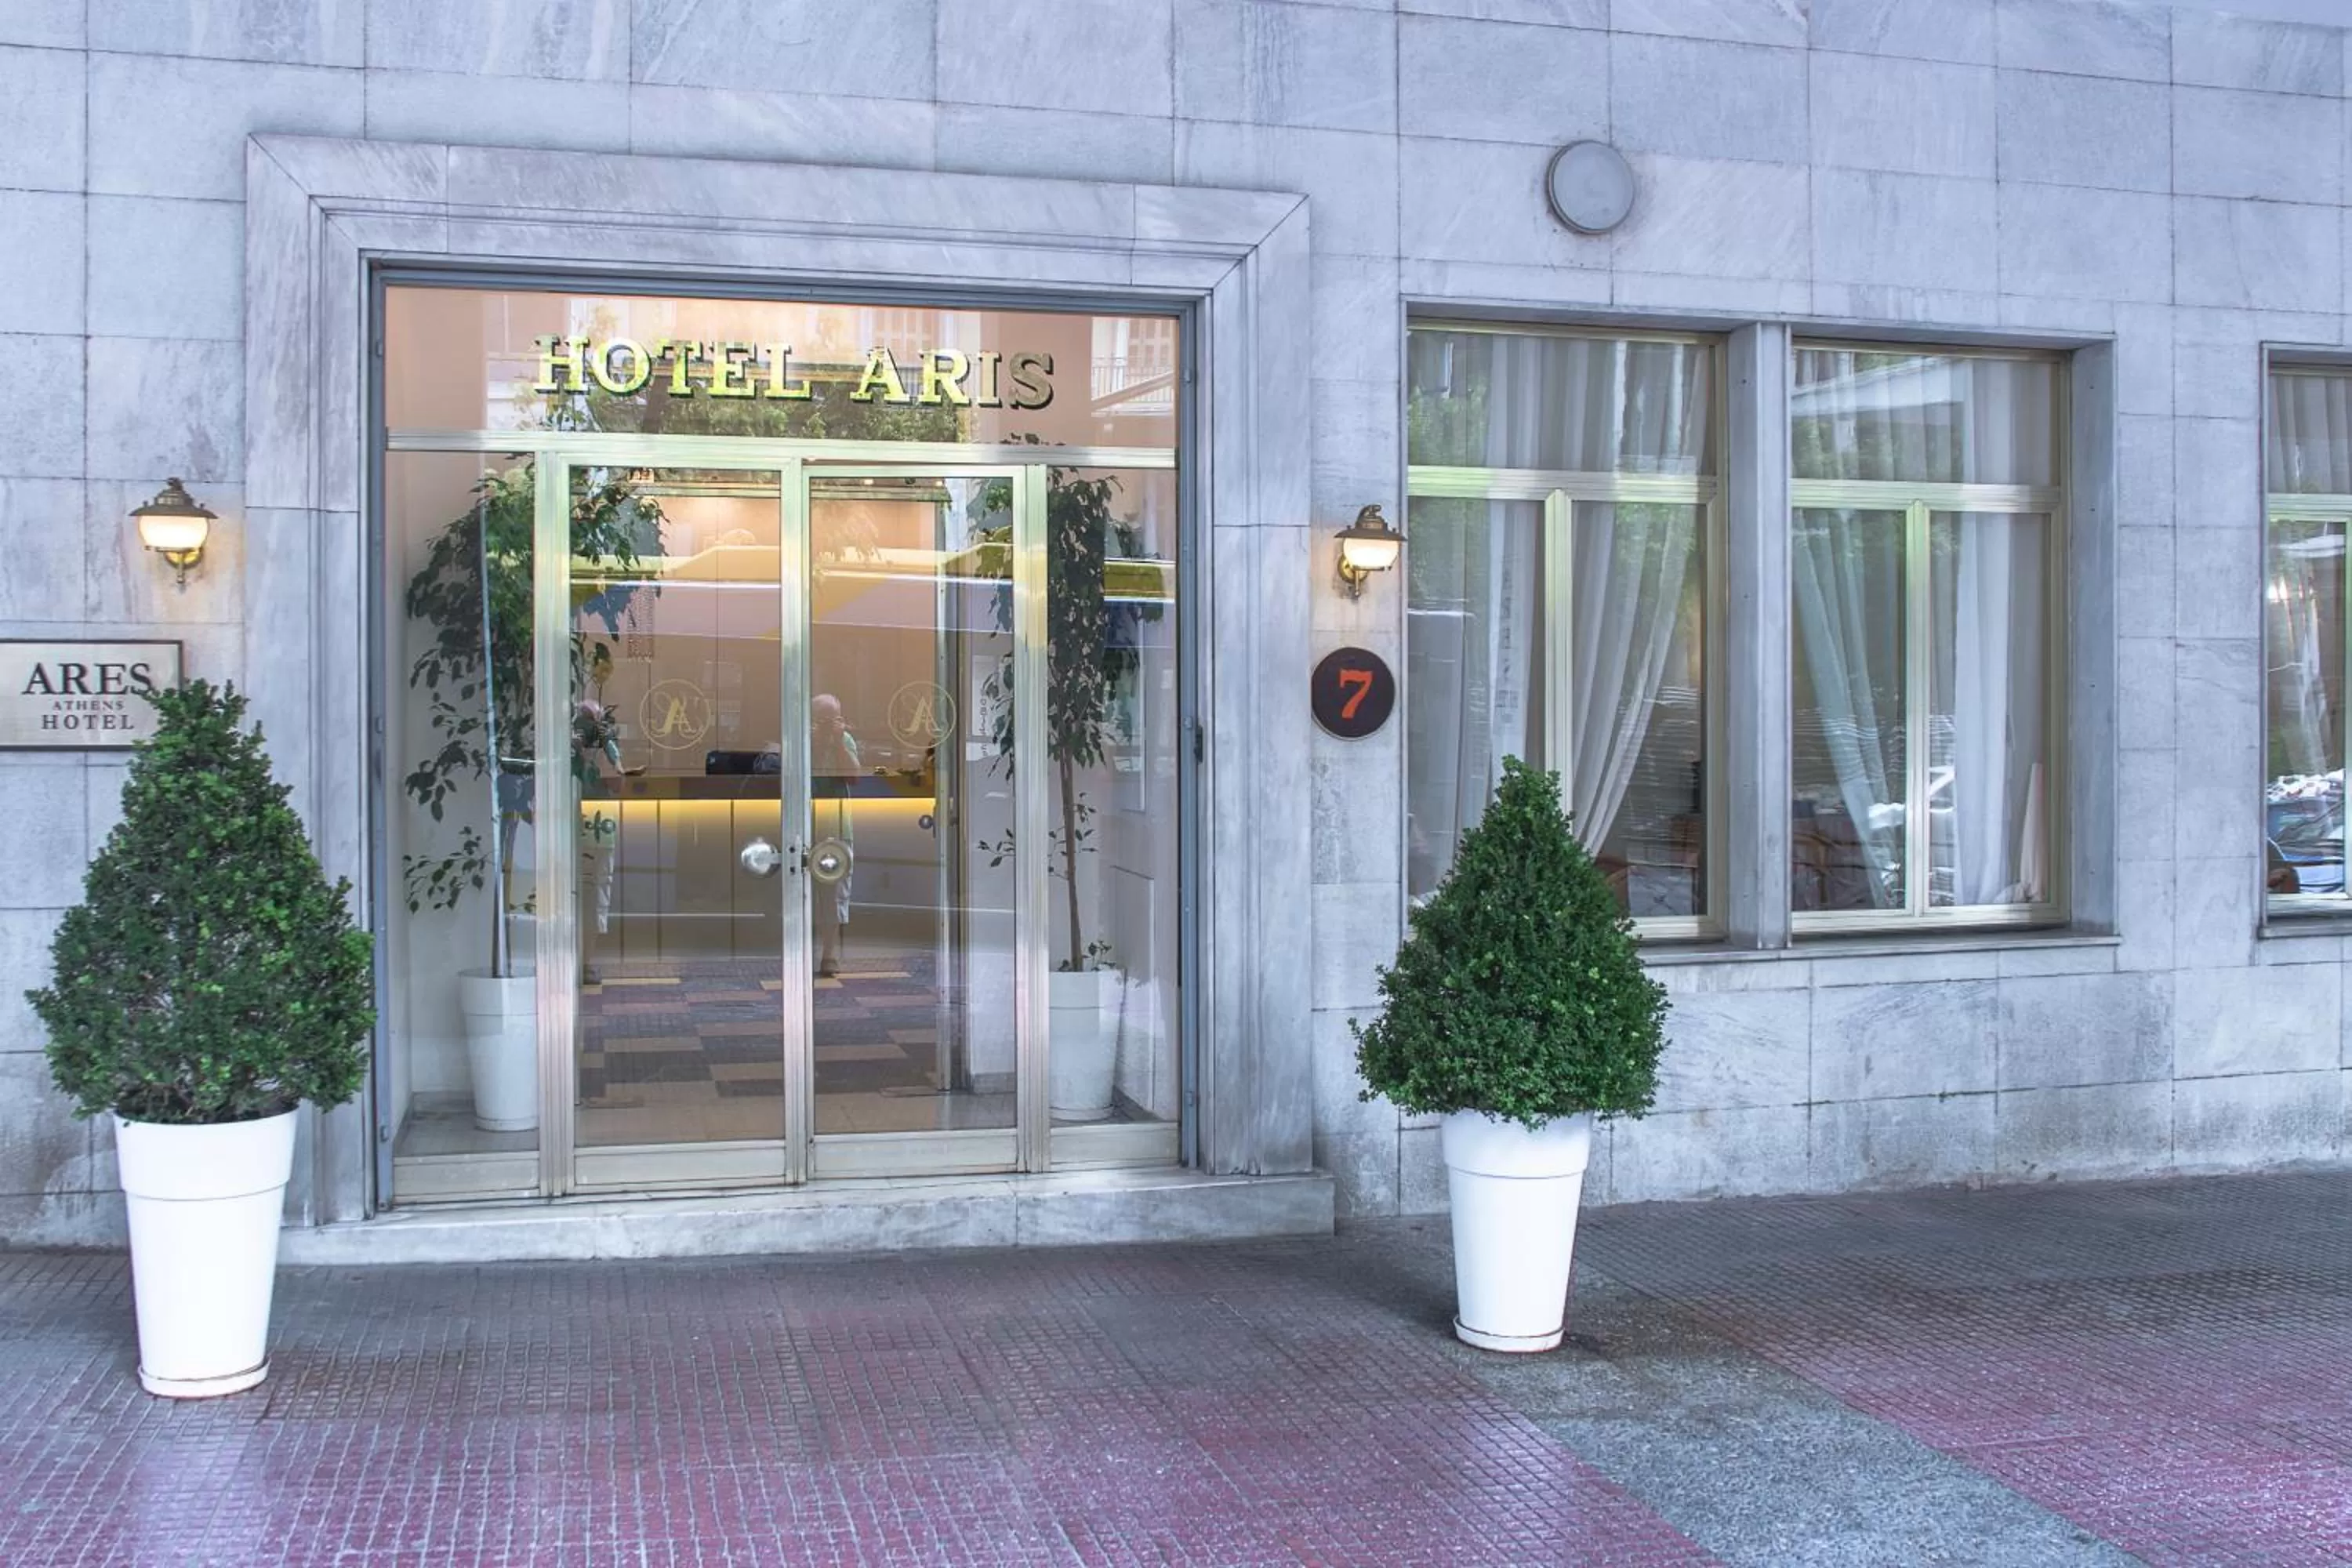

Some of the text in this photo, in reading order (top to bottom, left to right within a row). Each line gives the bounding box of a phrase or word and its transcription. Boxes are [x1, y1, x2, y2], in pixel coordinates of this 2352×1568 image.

[534, 335, 1054, 409] HOTEL ARIS
[21, 662, 152, 695] ARES
[1340, 670, 1373, 719] 7
[53, 700, 124, 710] ATHENS
[41, 714, 135, 730] HOTEL
